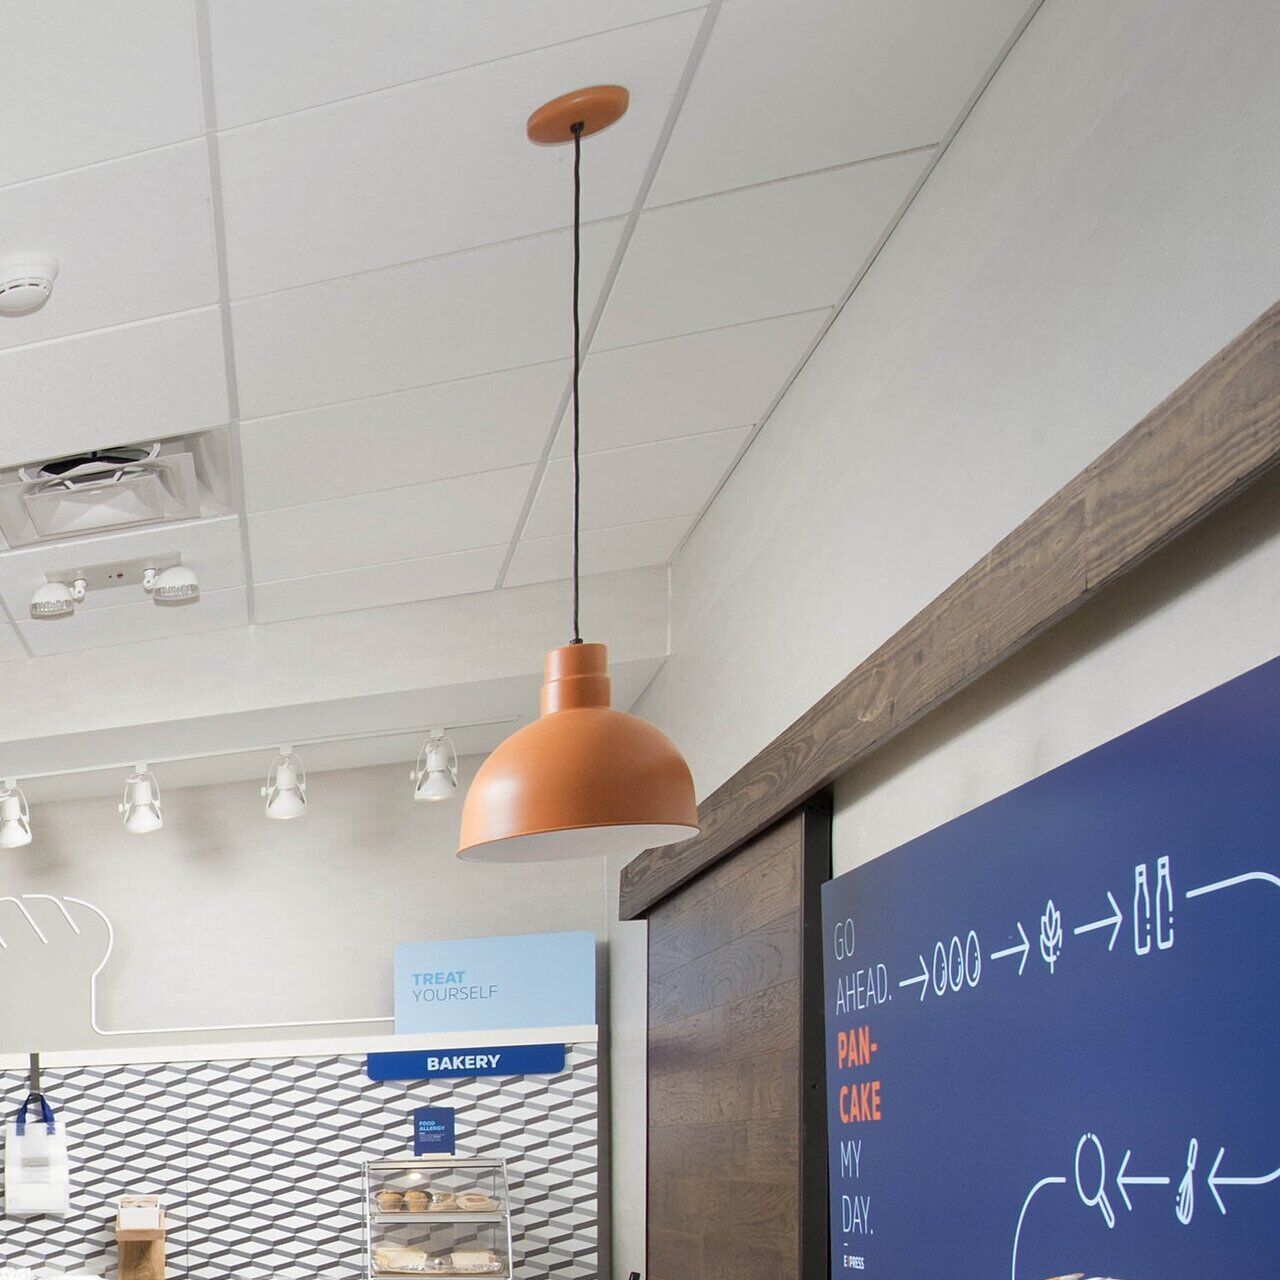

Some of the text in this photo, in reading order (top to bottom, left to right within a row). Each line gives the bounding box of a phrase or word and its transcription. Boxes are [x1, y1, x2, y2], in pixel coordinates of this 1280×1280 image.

[833, 917, 856, 961] GO
[412, 970, 466, 986] TREAT
[412, 984, 499, 1003] YOURSELF
[835, 962, 892, 1016] AHEAD.
[426, 1054, 501, 1071] BAKERY
[837, 1025, 878, 1070] PAN-
[838, 1080, 882, 1124] CAKE
[840, 1139, 862, 1179] MY
[842, 1194, 874, 1236] DAY.
